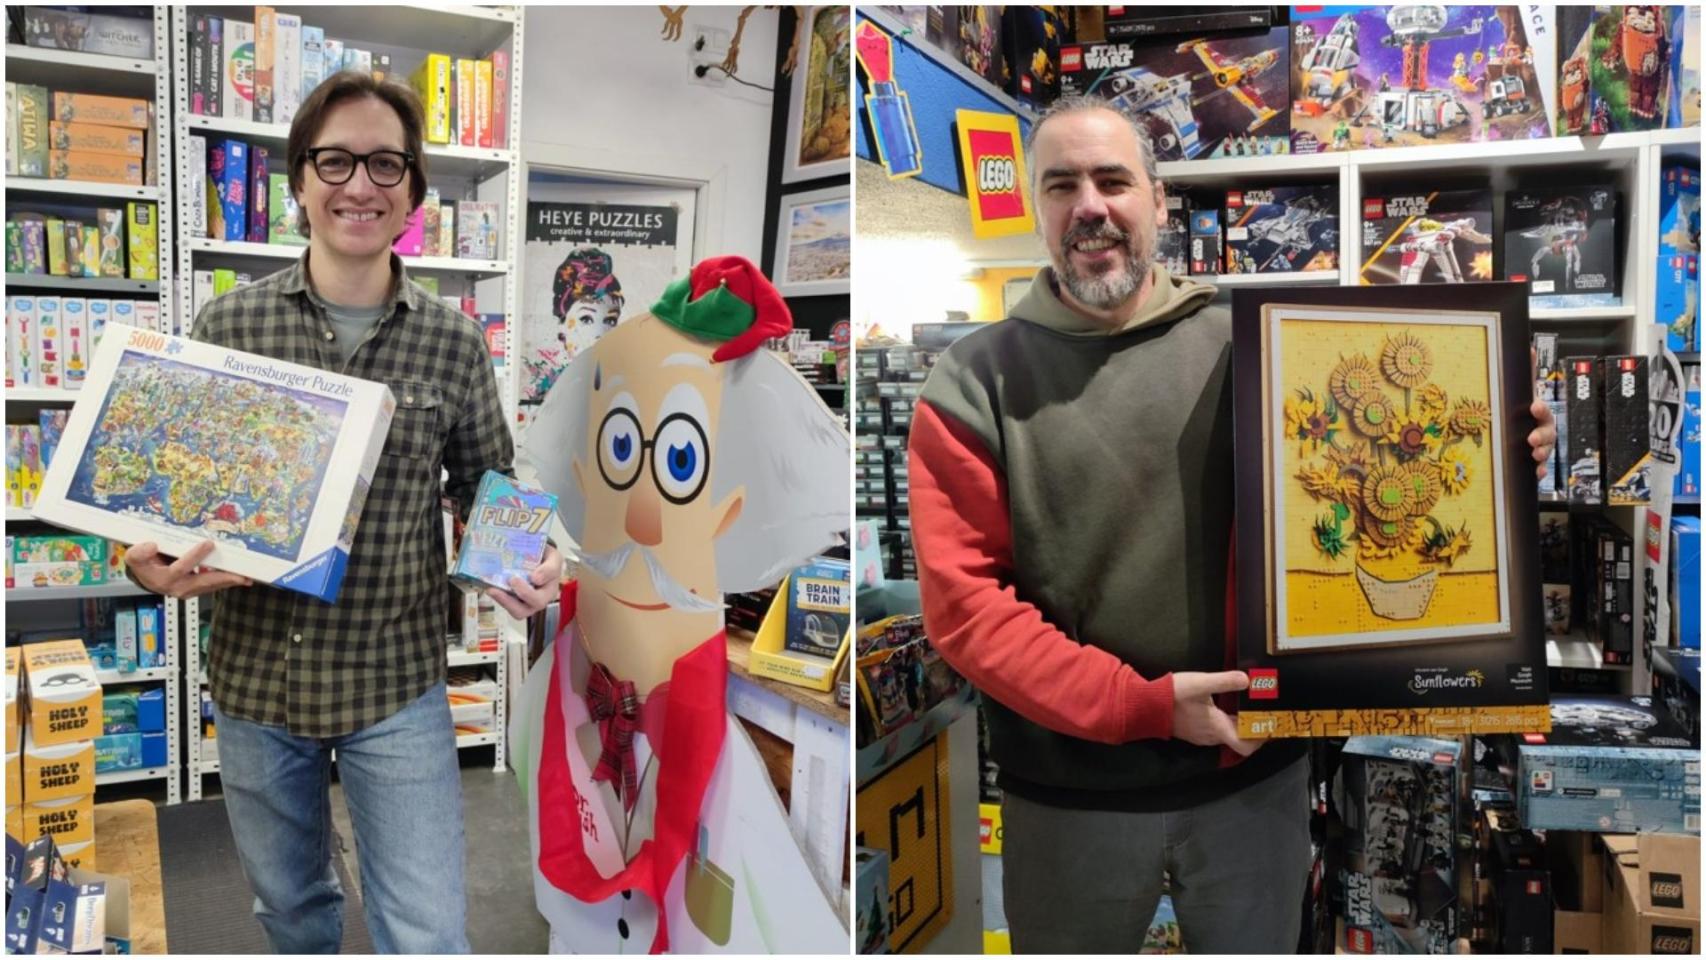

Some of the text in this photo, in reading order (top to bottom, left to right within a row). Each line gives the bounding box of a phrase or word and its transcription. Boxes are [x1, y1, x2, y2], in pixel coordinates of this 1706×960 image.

[1296, 25, 1311, 36] 8+
[1089, 43, 1133, 57] STAR
[1061, 53, 1080, 64] LEGO
[1084, 54, 1134, 69] WARS
[22, 94, 37, 150] ATIWA
[979, 158, 1014, 192] LEGO
[1244, 196, 1275, 205] WARS
[1391, 197, 1428, 207] STAR
[1386, 205, 1428, 217] WARS
[539, 211, 663, 228] HEYE PUZZLES
[550, 228, 583, 236] creative
[594, 230, 651, 240] extraordinary
[128, 330, 165, 351] 5000
[223, 355, 354, 397] Ravensburger Puzzle
[481, 506, 552, 534] FLIP 7
[282, 555, 328, 586] Ravensburger
[806, 583, 840, 595] BRAIN
[806, 593, 841, 605] TRAIN
[1251, 678, 1276, 689] LEGO
[1414, 675, 1476, 690] Sunflowers
[49, 706, 88, 721] HOLY
[49, 719, 88, 733] SHEEP
[1251, 720, 1274, 733] art
[39, 762, 80, 777] HOLY
[40, 774, 80, 789] SHEEP
[39, 809, 78, 825] HOLY
[39, 821, 78, 836] SHEEP
[1653, 882, 1680, 896] LEGO
[1348, 873, 1360, 921] STAR
[1359, 875, 1372, 925] WARS
[1655, 937, 1689, 952] LEGO
